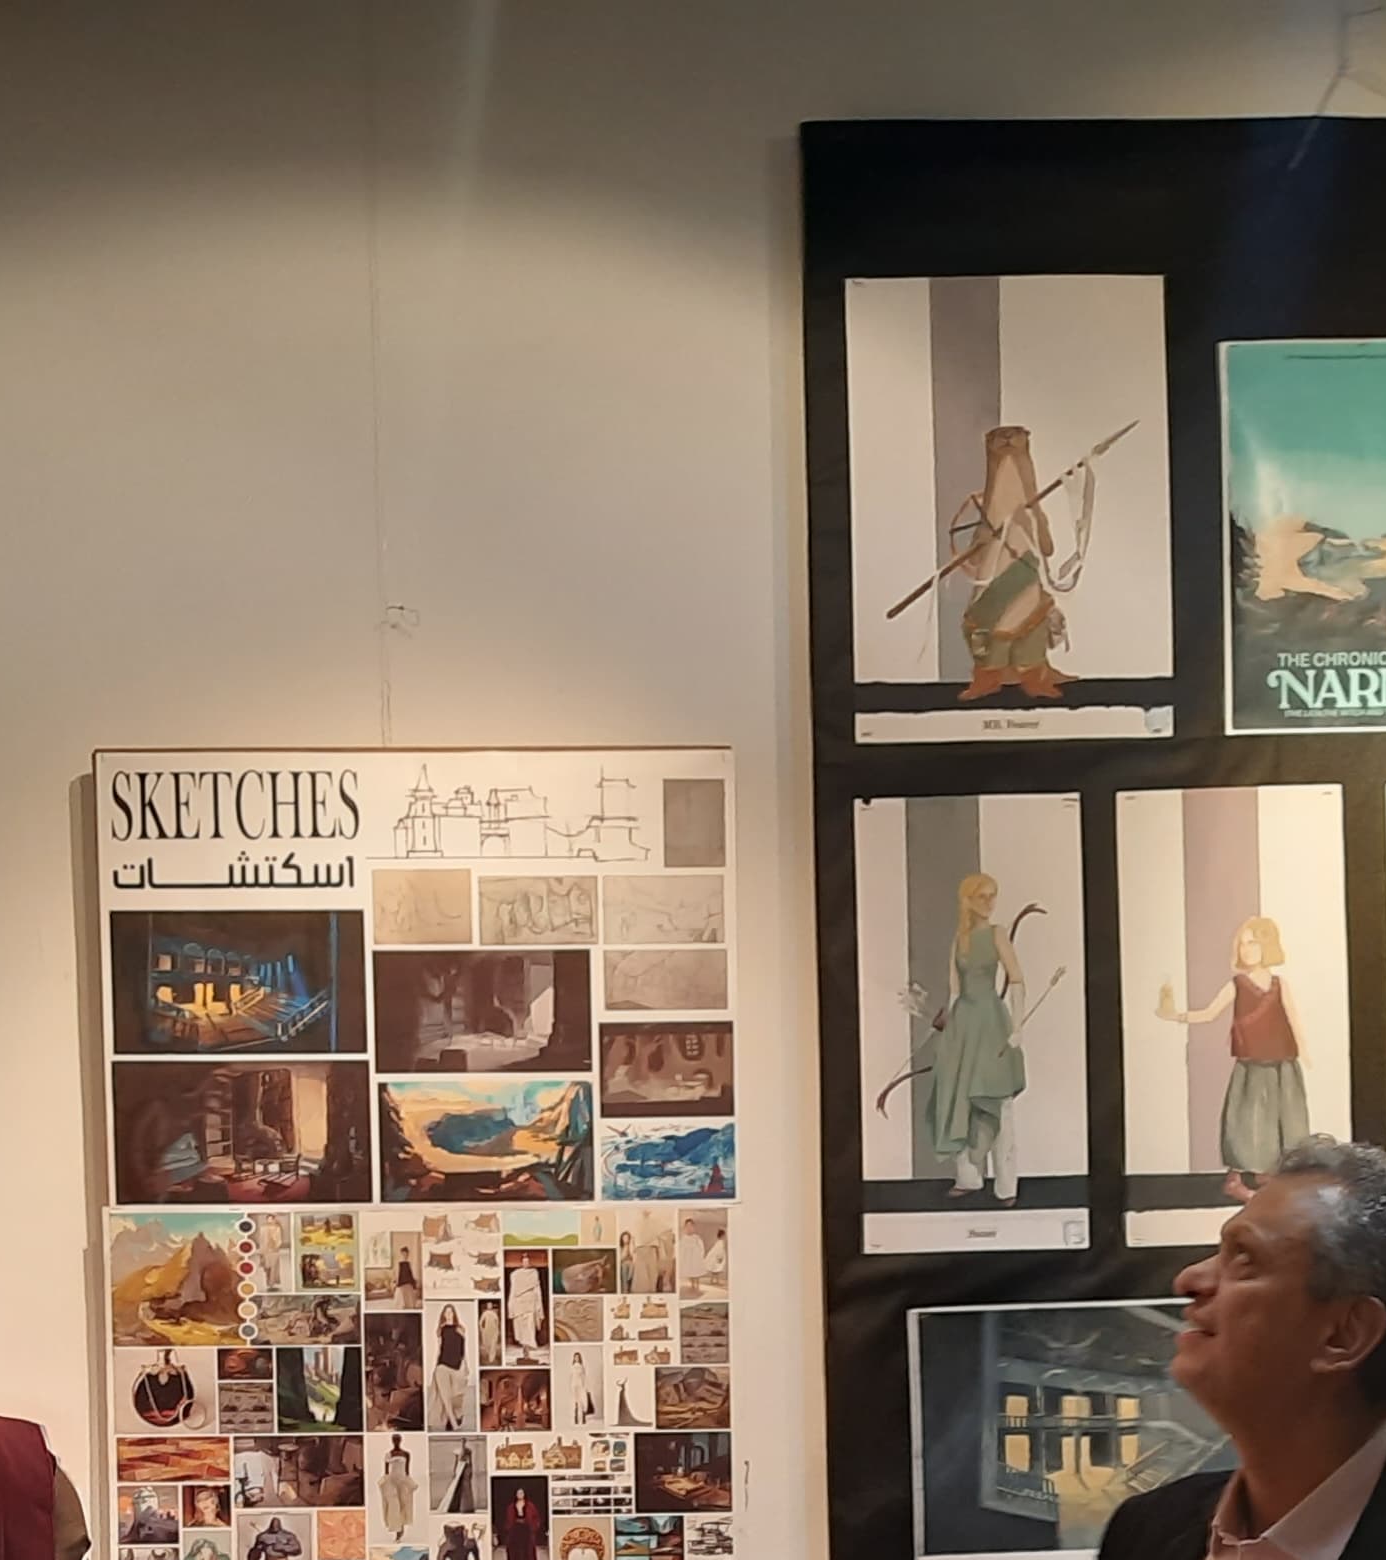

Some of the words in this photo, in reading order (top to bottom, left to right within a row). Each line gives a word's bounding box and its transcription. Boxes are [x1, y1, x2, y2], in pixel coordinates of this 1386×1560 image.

[1277, 652, 1310, 668] THE
[111, 769, 360, 841] SKETCHES
[113, 851, 355, 889] اسكتشات
